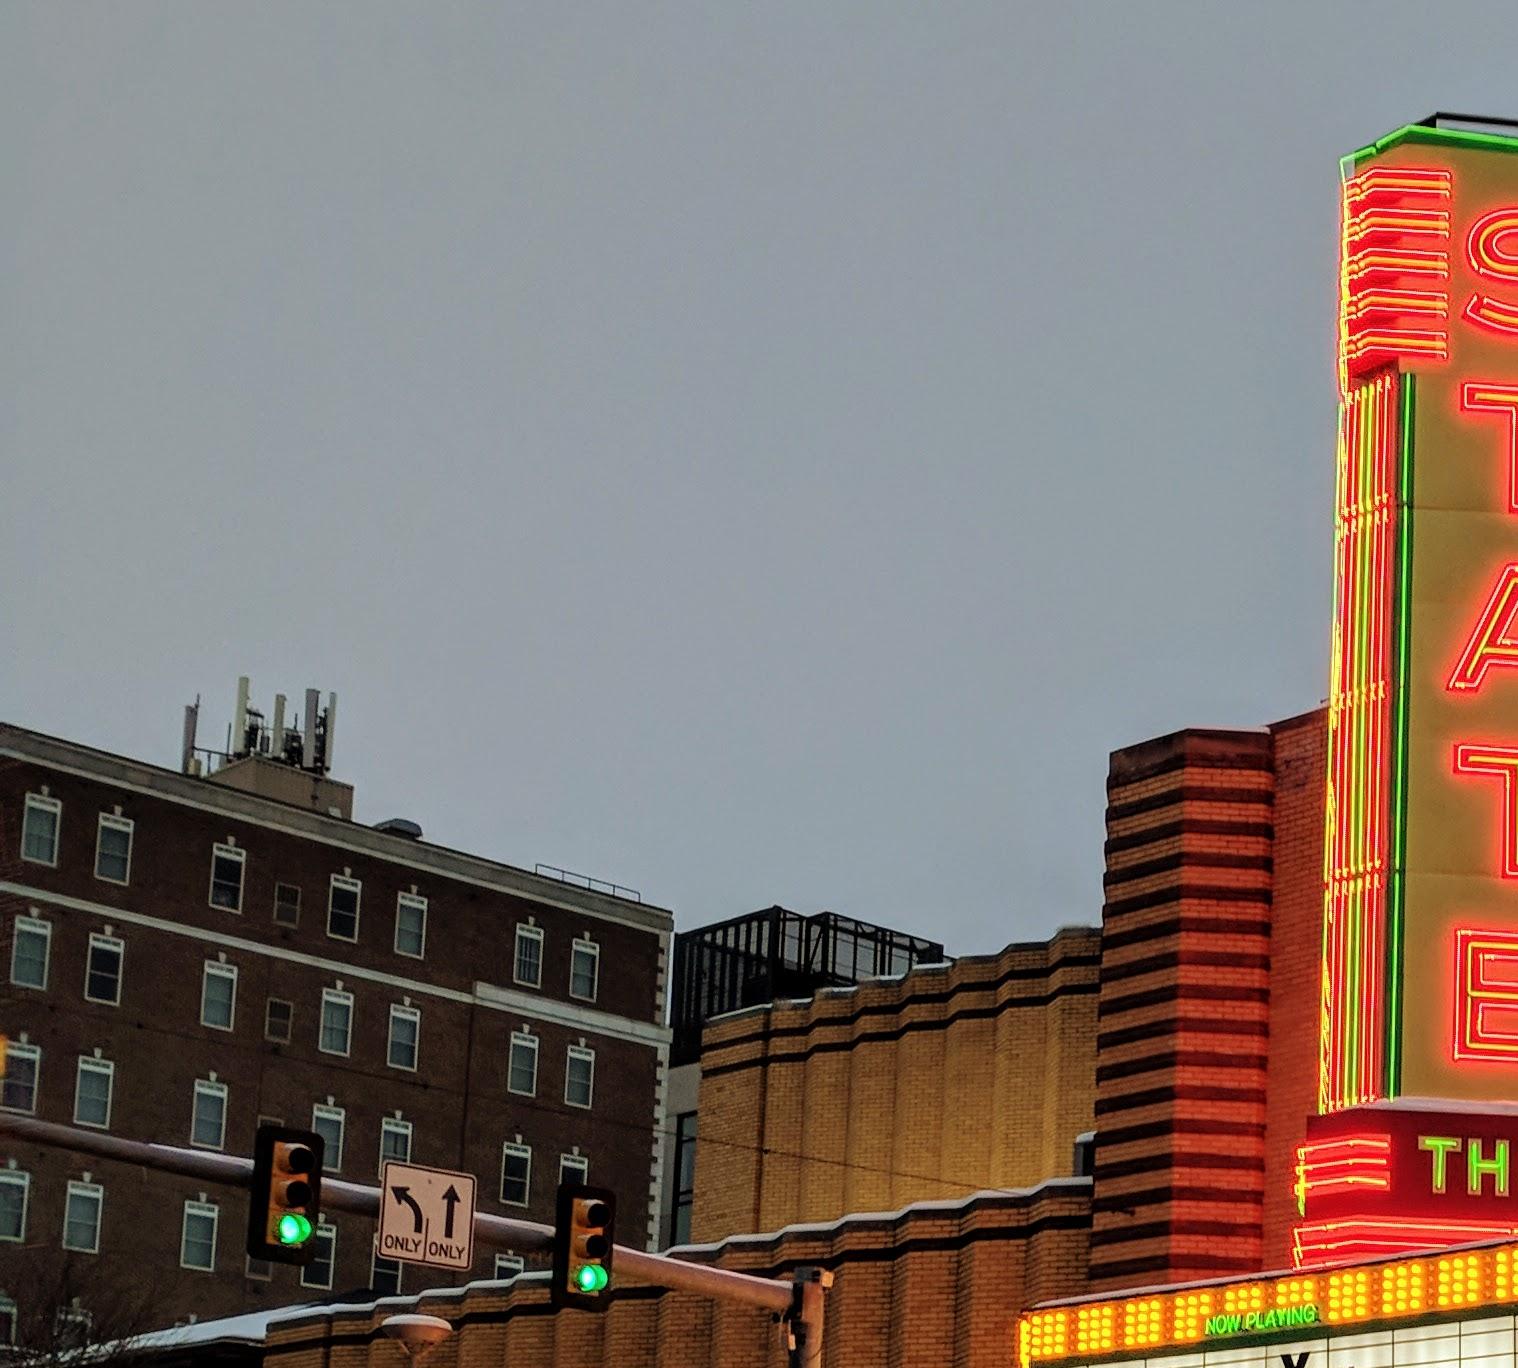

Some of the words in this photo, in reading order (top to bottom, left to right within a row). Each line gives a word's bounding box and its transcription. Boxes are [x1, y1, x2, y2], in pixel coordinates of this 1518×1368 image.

[384, 1234, 421, 1254] ONLY
[428, 1241, 466, 1261] ONLY
[1205, 1314, 1242, 1335] NOW
[1245, 1303, 1319, 1331] PLAYING
